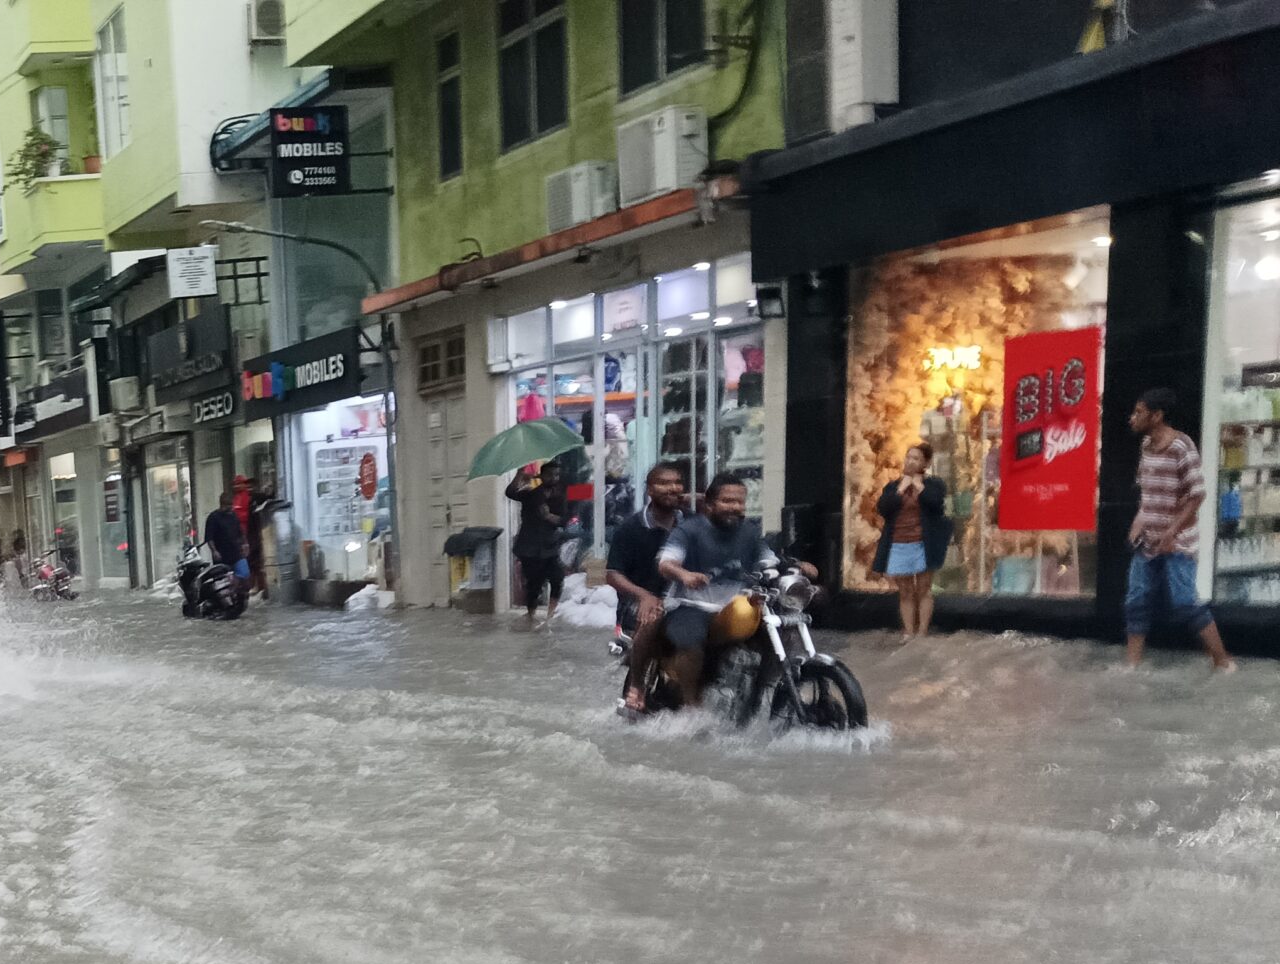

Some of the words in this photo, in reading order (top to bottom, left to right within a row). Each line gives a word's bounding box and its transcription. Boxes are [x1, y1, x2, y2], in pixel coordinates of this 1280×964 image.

[277, 141, 344, 158] MOBILES
[295, 352, 345, 389] MOBILES
[193, 391, 233, 425] DESEO
[1015, 357, 1086, 425] BIG
[1043, 417, 1087, 466] Sale
